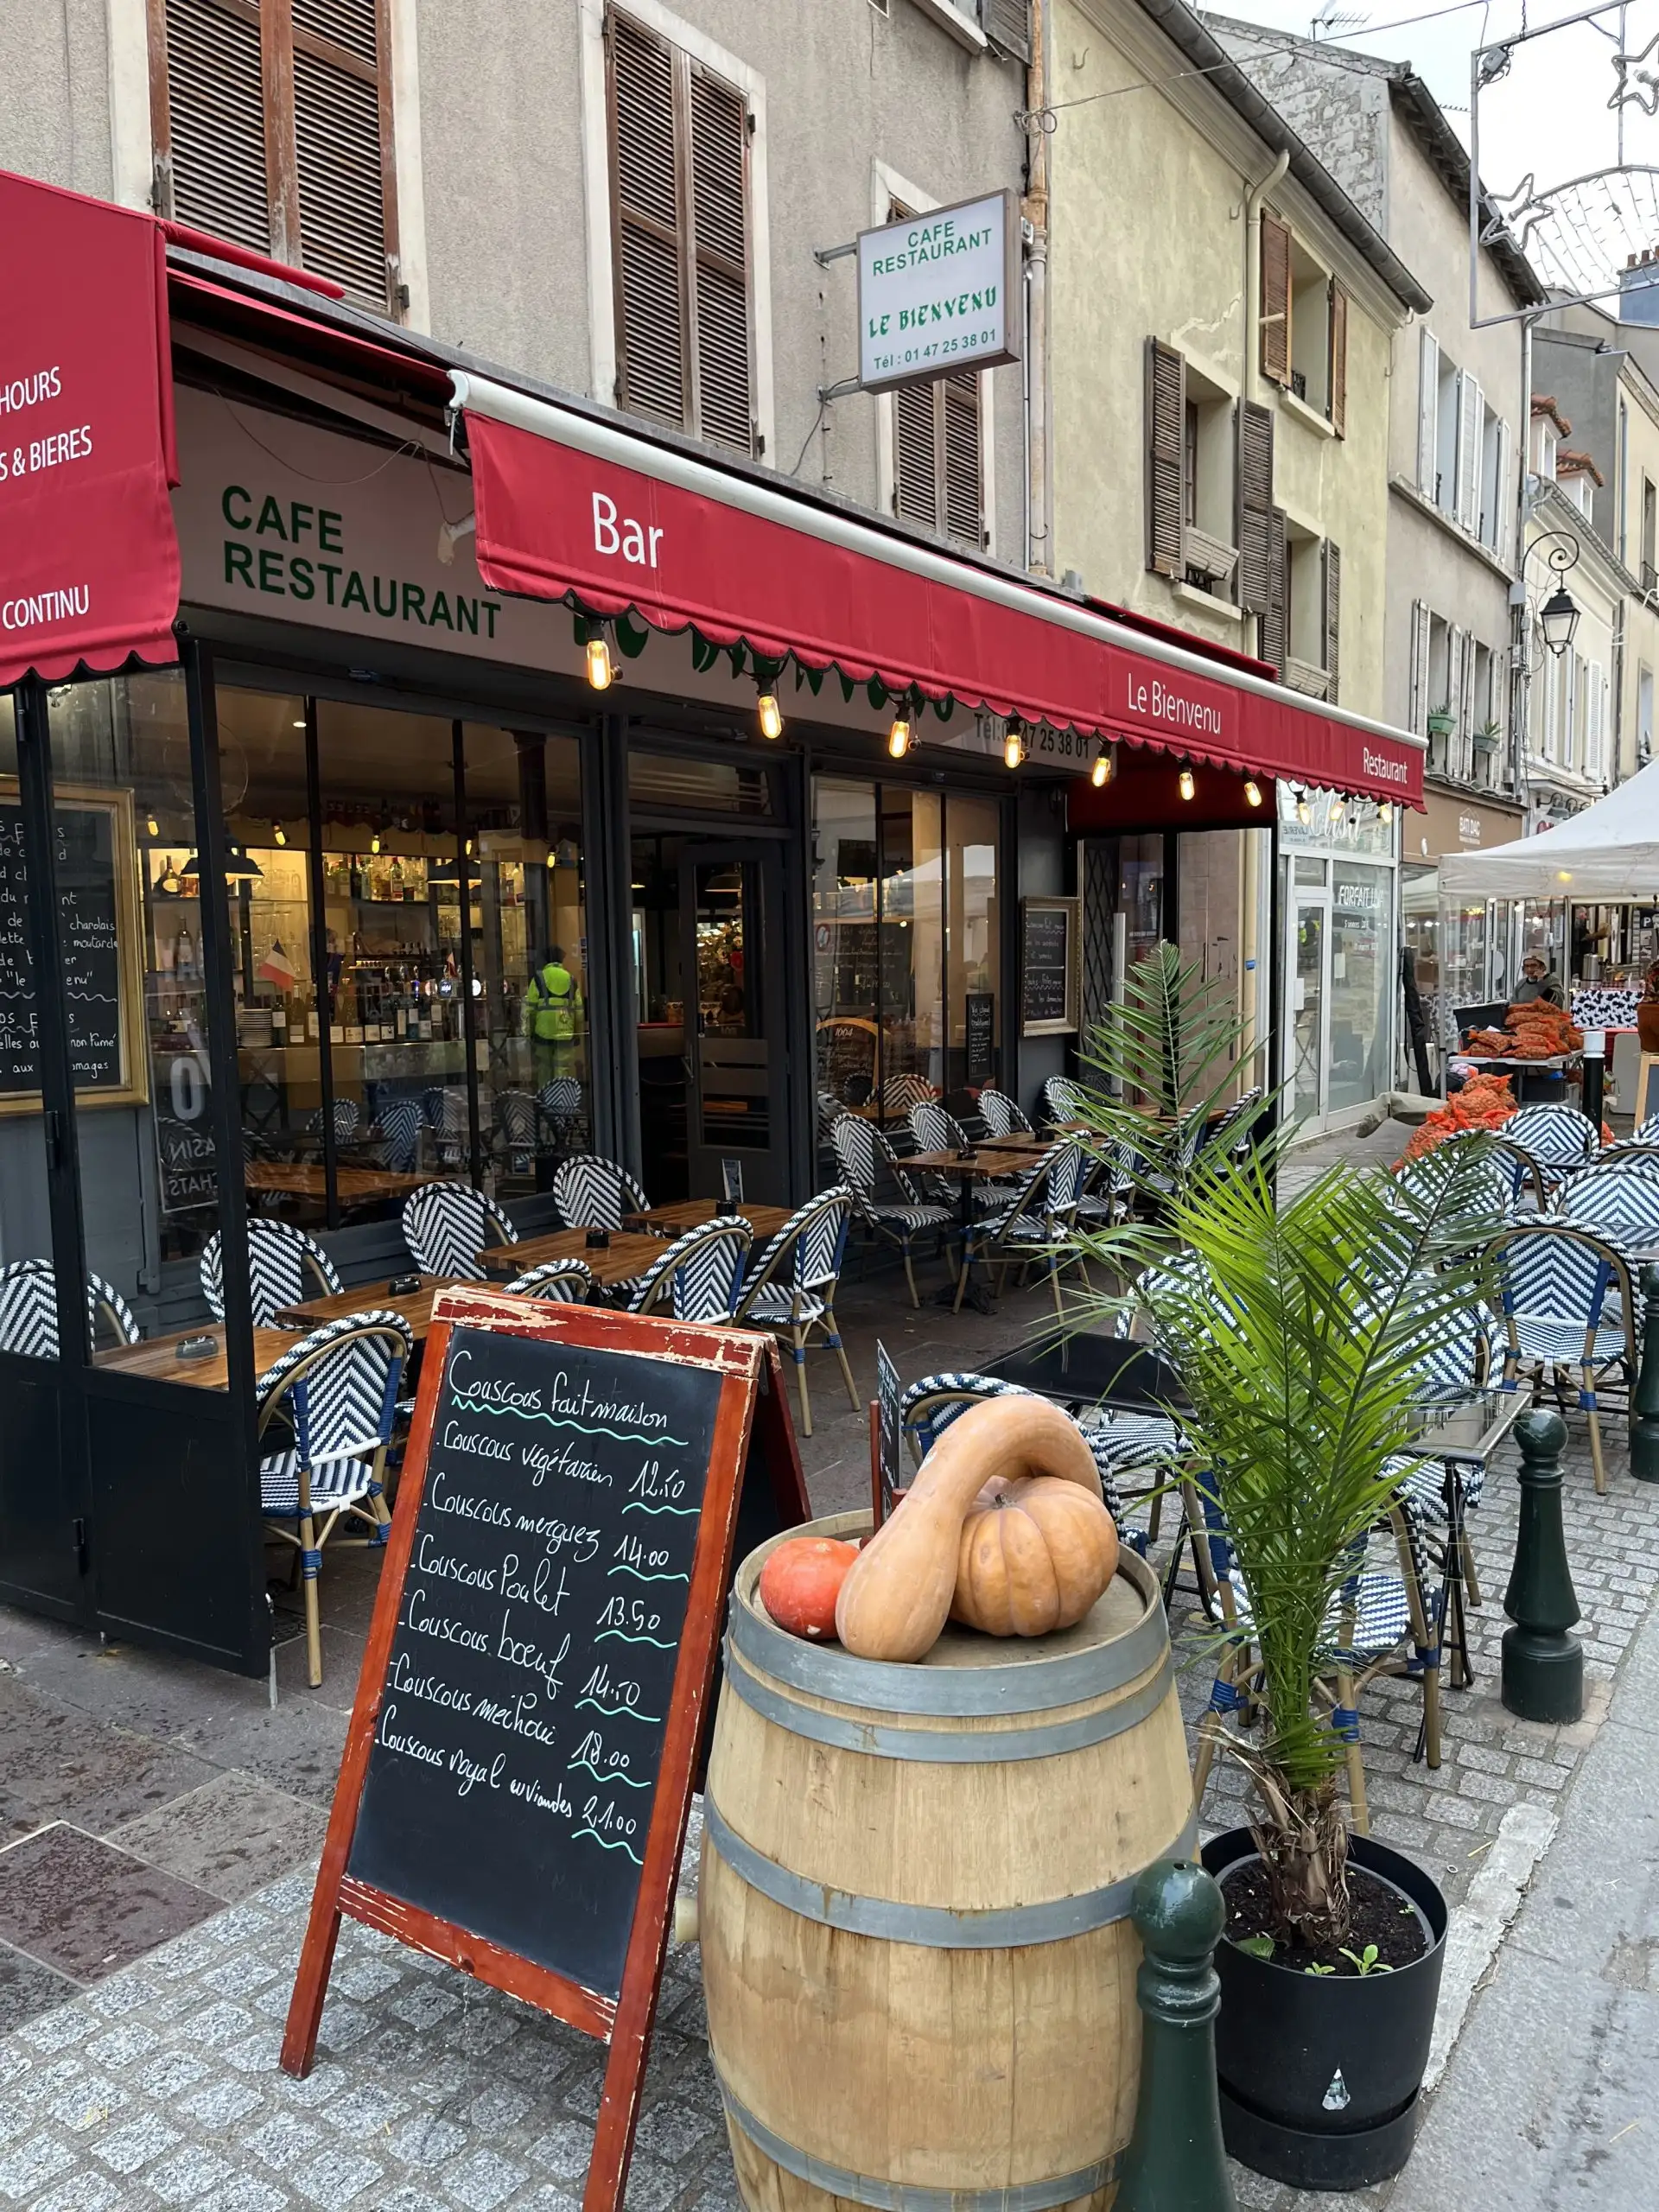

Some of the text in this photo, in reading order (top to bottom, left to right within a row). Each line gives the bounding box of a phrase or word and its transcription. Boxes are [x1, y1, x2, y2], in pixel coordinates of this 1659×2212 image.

[873, 228, 992, 276] RESTAURANT
[907, 220, 955, 248] CAFE
[868, 286, 996, 339] LE BIENVENU
[905, 348, 919, 363] 01
[923, 343, 939, 359] 47
[942, 339, 958, 354] 25
[962, 334, 977, 349] 38
[981, 328, 996, 344] 01
[0, 366, 61, 415] HOURS
[12, 448, 26, 476] &
[29, 425, 92, 472] BIERES
[221, 485, 344, 555] CAFE
[591, 491, 664, 569] Bar
[2, 584, 89, 630] CONTINU
[224, 540, 501, 639] RESTAURANT
[1128, 672, 1221, 734] Le Bienvenu
[1040, 728, 1054, 752] 25
[1058, 733, 1072, 756] 38
[1076, 736, 1089, 759] 01
[1363, 747, 1408, 785] Restaurant
[8, 912, 23, 927] de
[13, 1064, 34, 1072] aux
[448, 1350, 667, 1427] Couscous fait maison
[444, 1421, 515, 1461] Couscous
[431, 1471, 512, 1528] Couscous
[515, 1515, 602, 1562] merguez
[419, 1534, 497, 1591] Couscous
[499, 1554, 570, 1616] Poulet
[409, 1589, 489, 1652] Couscous
[394, 1653, 473, 1711] Couscous
[381, 1705, 446, 1766] Couscous
